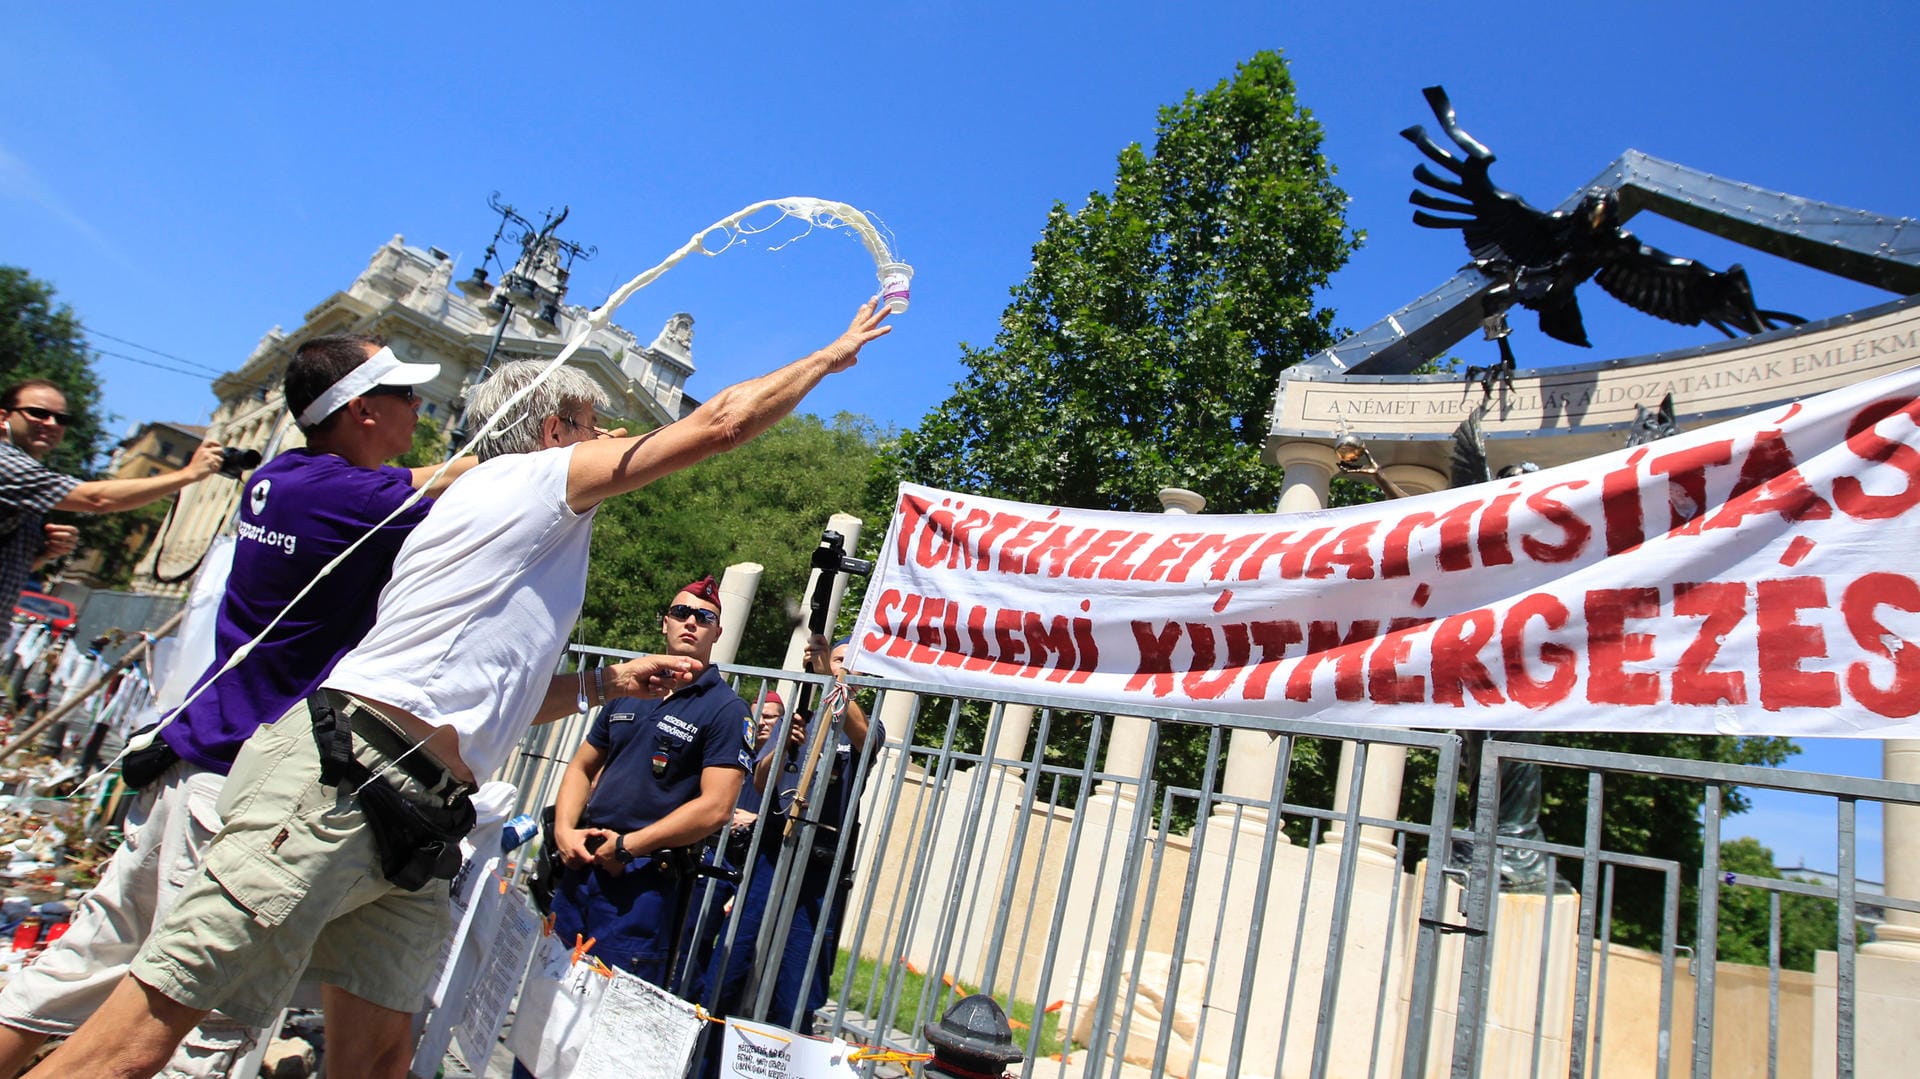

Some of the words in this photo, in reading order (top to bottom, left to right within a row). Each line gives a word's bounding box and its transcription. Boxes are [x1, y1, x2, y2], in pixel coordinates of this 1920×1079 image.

[1328, 401, 1341, 414] A
[1350, 397, 1417, 415] NÉMET
[1577, 359, 1783, 406] ÁLDOZATAINAK
[1792, 329, 1920, 374] EMLÉKM
[1124, 535, 1920, 719] KÚTMÉRGEZÉS
